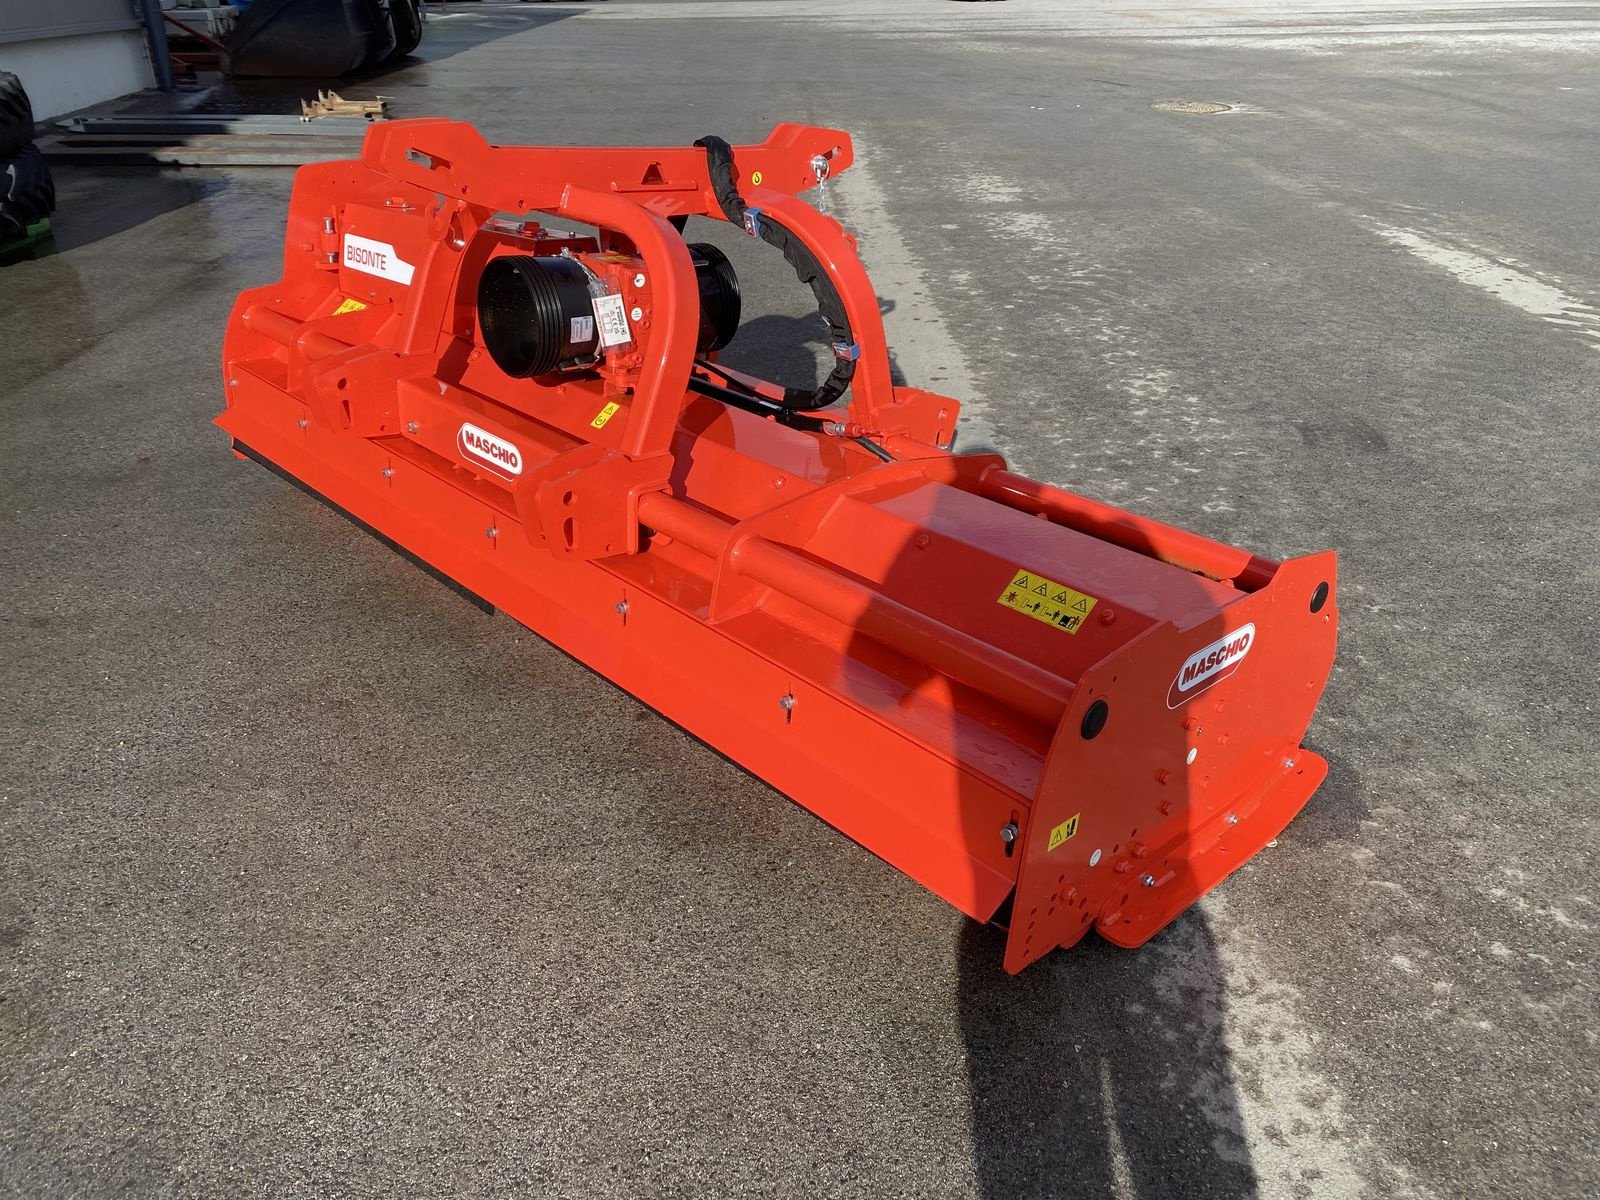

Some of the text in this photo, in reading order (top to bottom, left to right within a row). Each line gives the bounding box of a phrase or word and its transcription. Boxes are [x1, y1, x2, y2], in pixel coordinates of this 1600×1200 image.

[347, 245, 387, 271] BISONTE
[465, 430, 518, 468] MASCHIO
[1182, 633, 1250, 686] MASCHIO
